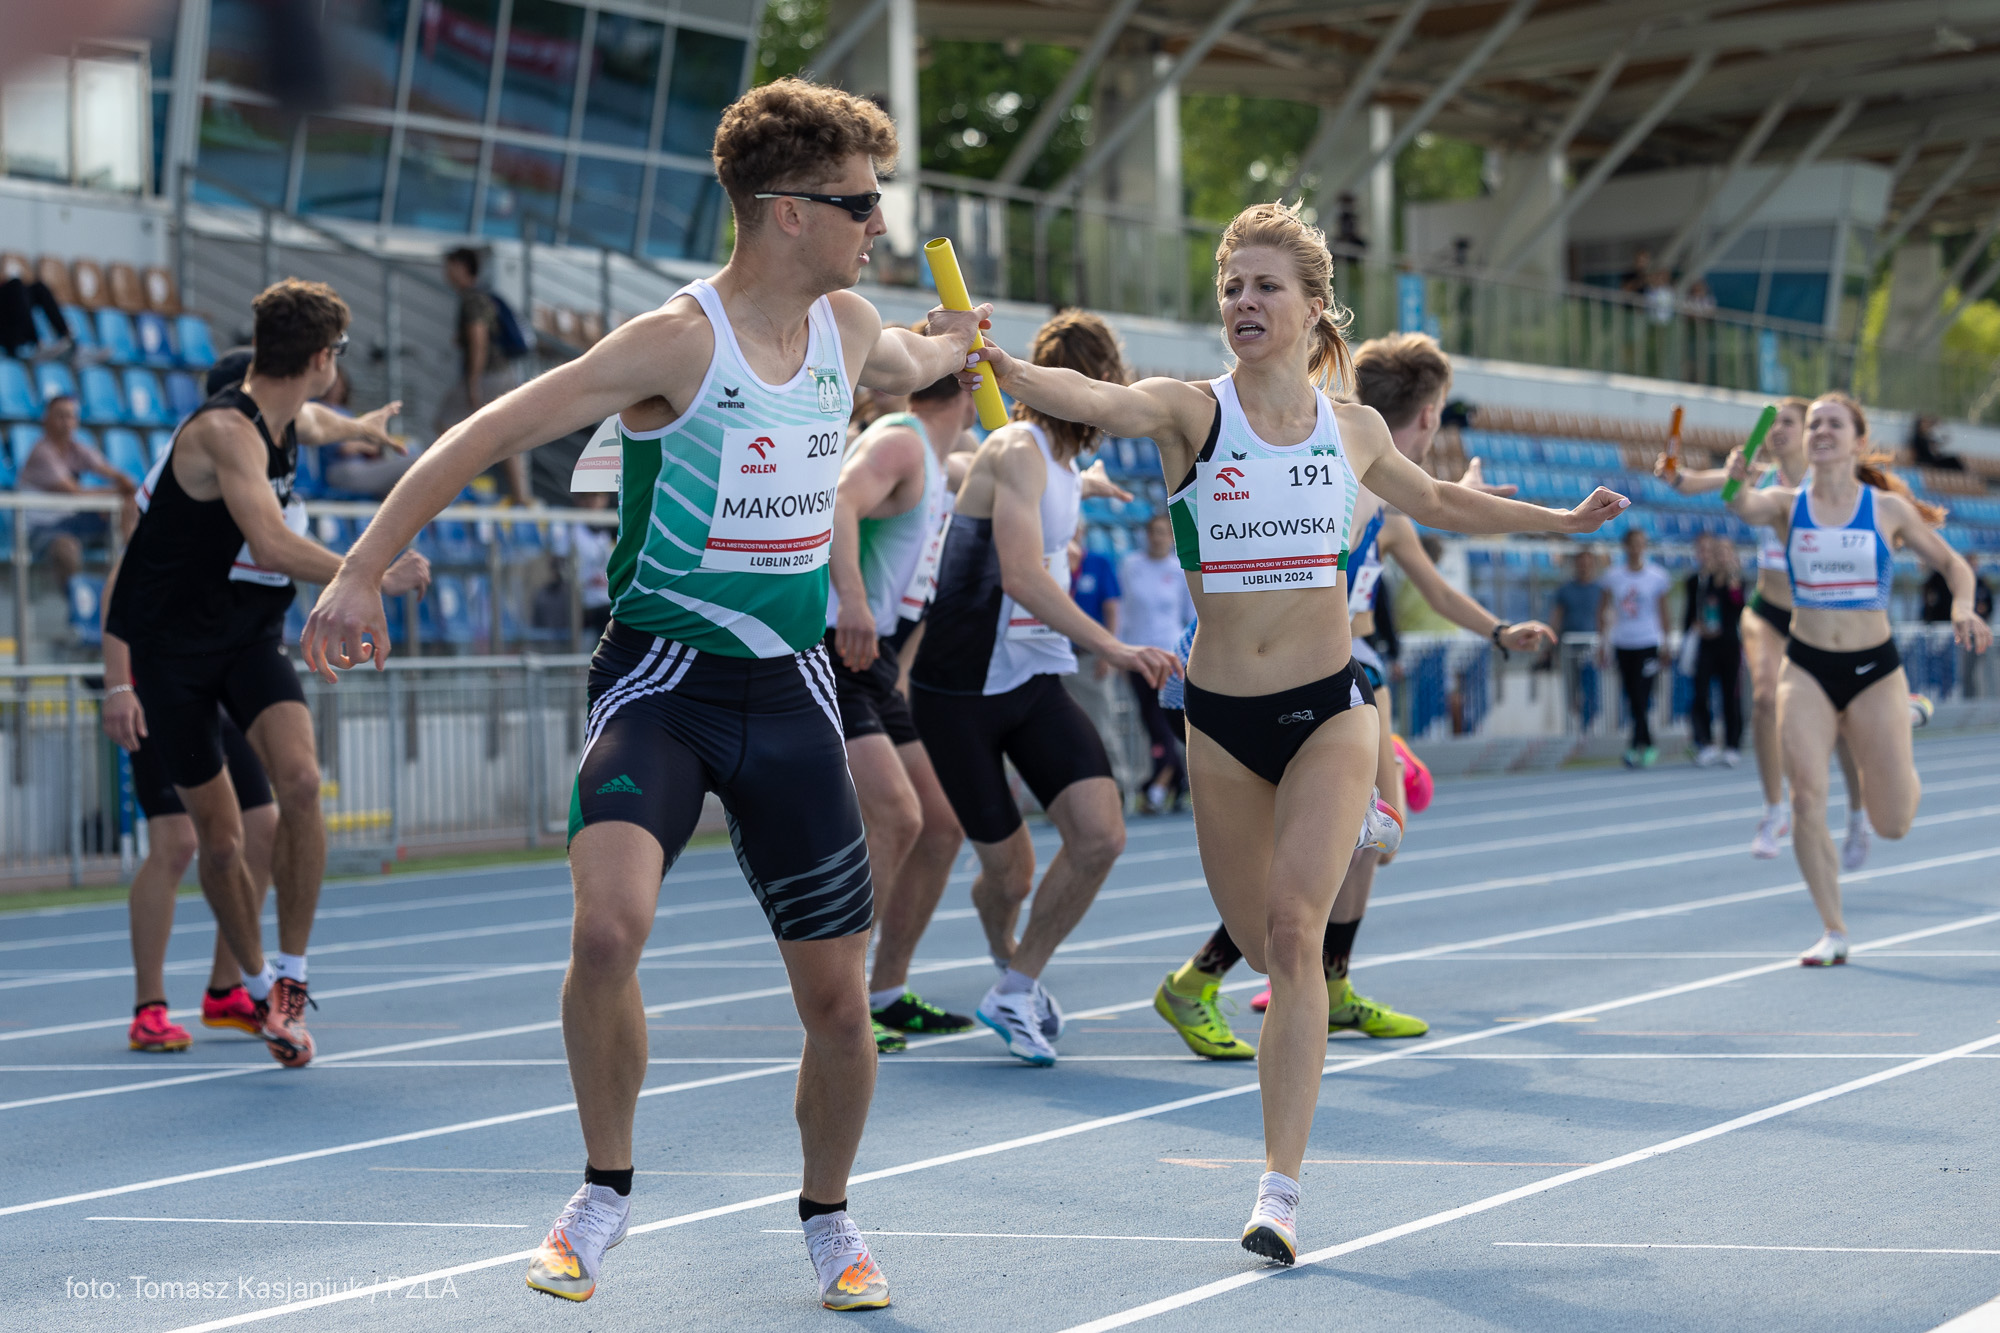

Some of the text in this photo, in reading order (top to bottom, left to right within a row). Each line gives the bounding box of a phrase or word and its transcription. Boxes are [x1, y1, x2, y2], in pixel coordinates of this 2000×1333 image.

[717, 400, 745, 409] erima
[807, 431, 839, 459] 202
[740, 463, 777, 474] ORLEN
[1288, 464, 1333, 487] 191
[1213, 490, 1250, 502] ORLEN
[721, 487, 835, 519] MAKOWSKI
[1210, 516, 1336, 540] GAJKOWSKA
[726, 542, 768, 550] MISTRZOSTWA
[750, 553, 814, 567] LUBLIN 2024
[1218, 562, 1255, 570] MISTRZOSTWA
[1242, 571, 1314, 586] LUBLIN 2024
[596, 785, 642, 795] adidas
